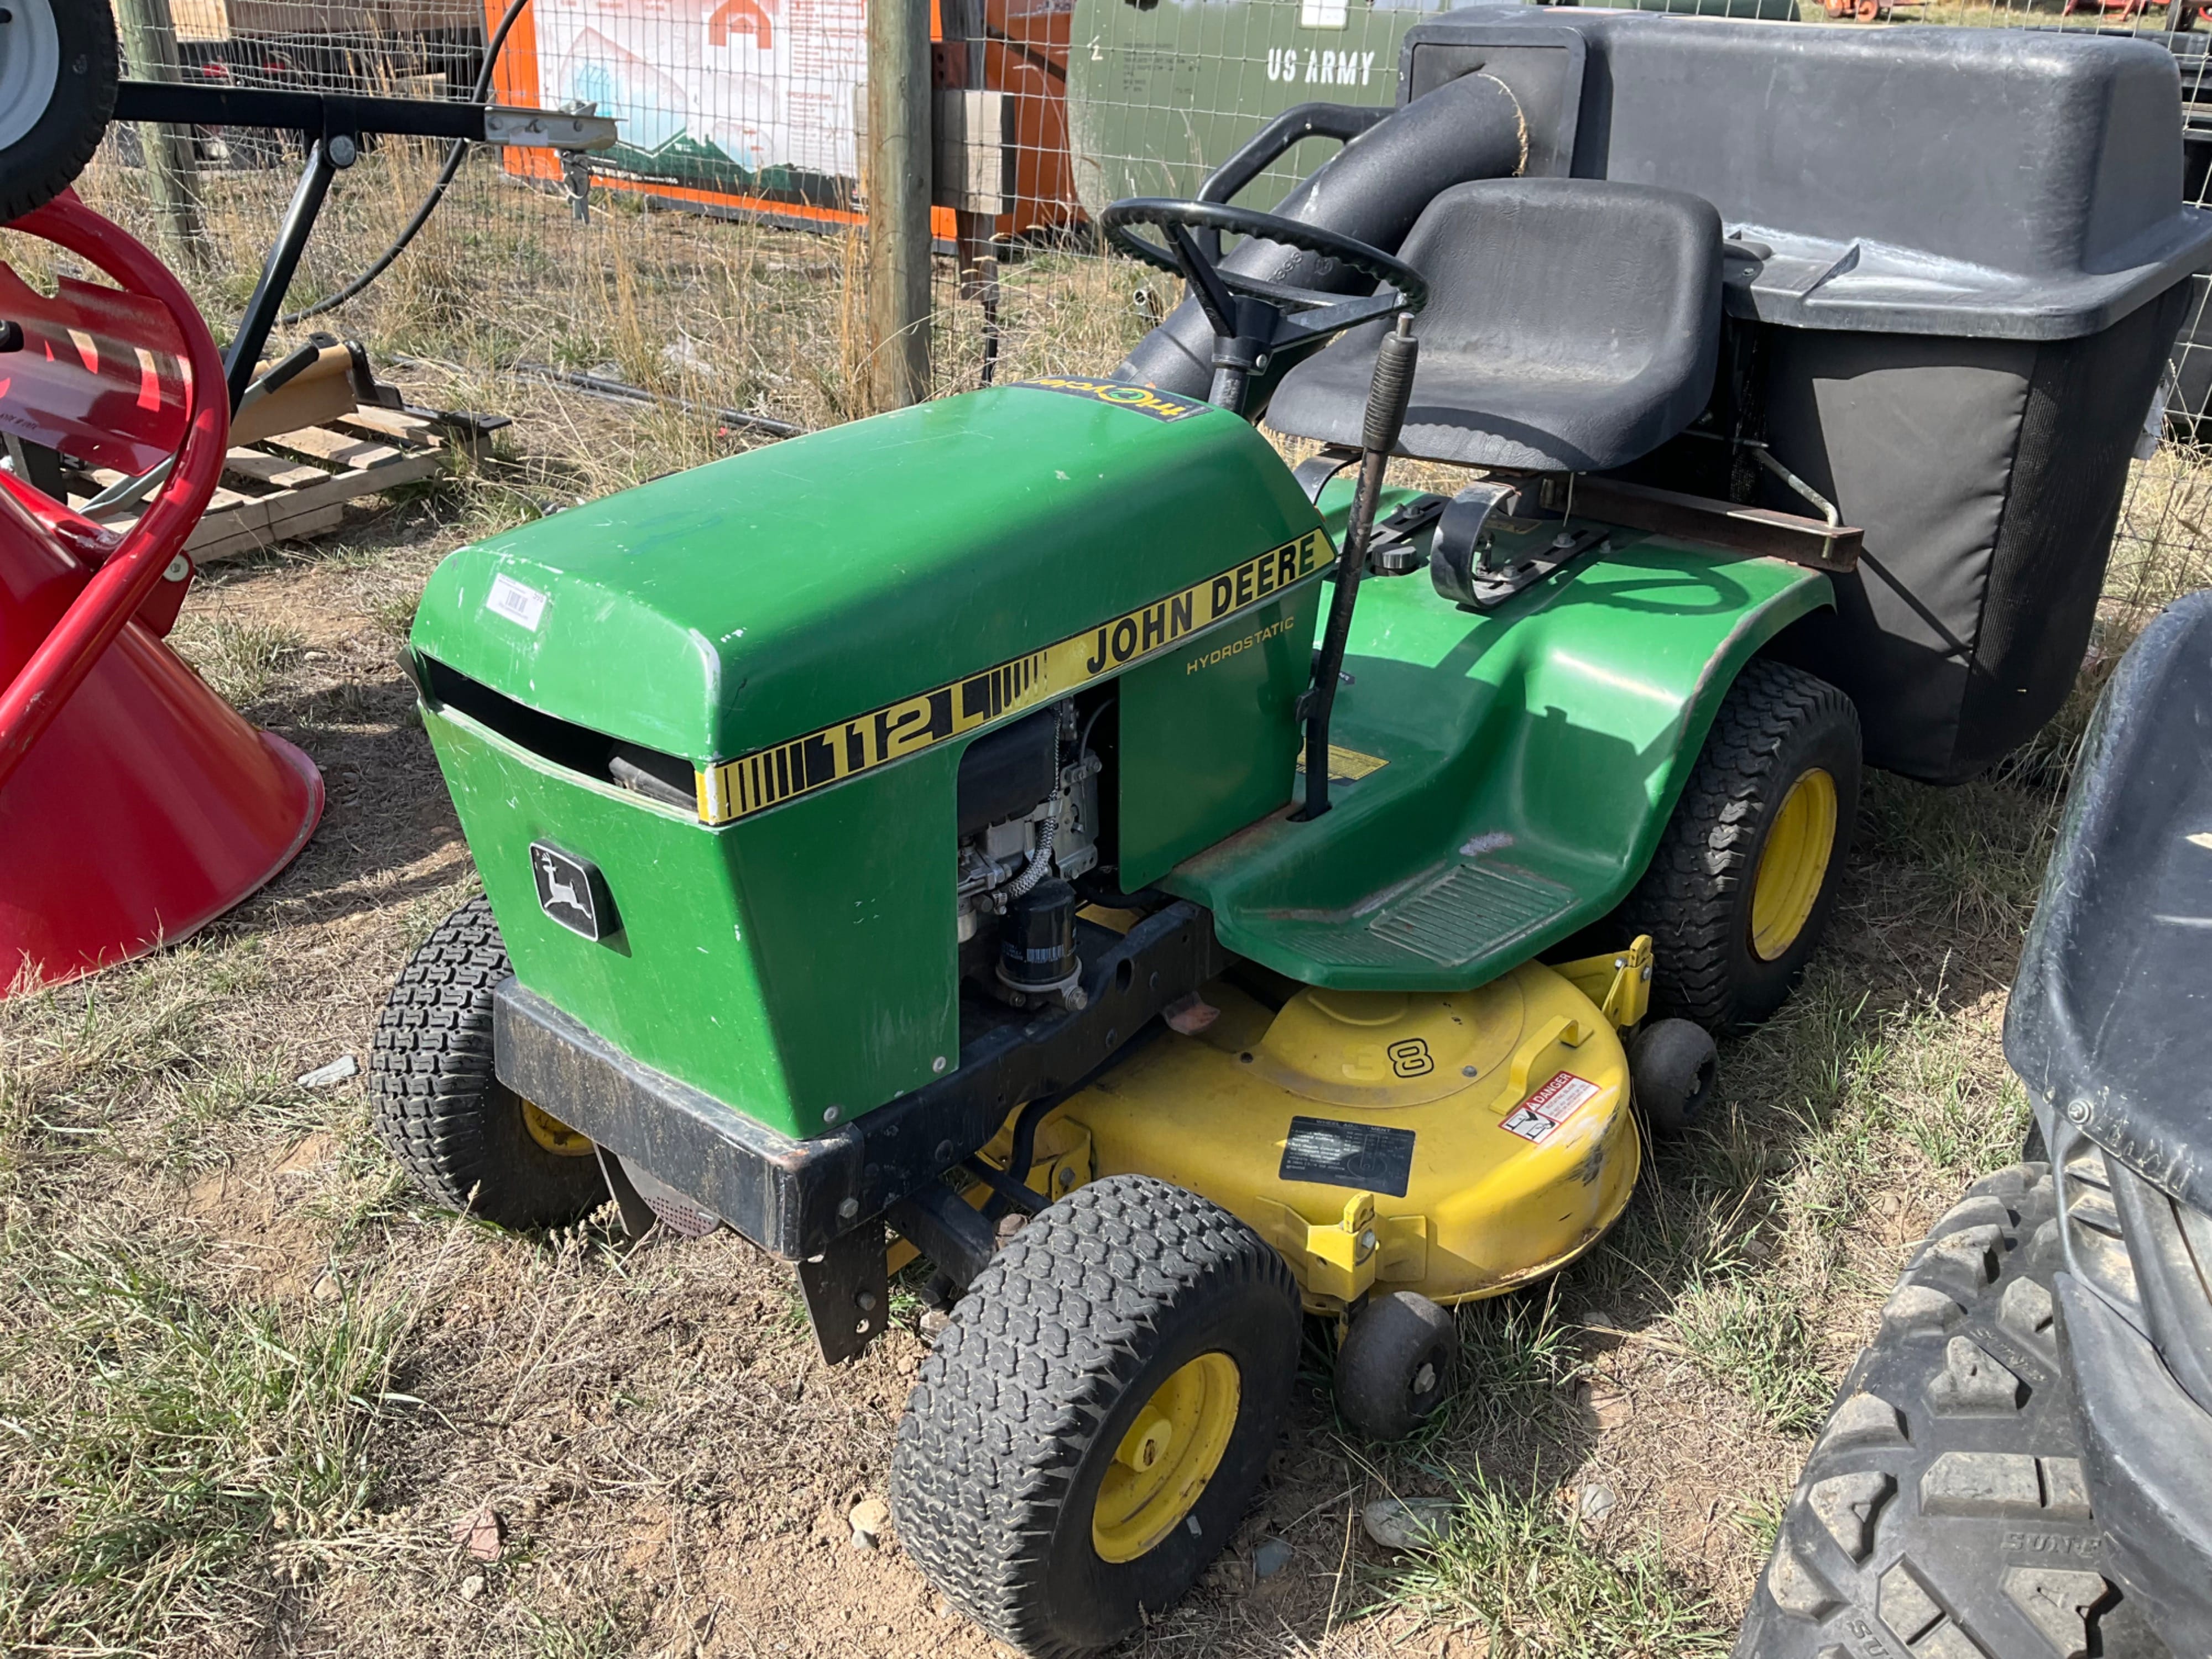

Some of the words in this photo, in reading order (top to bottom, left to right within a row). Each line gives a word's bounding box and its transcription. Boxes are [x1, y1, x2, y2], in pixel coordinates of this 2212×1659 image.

[1267, 48, 1297, 81] US
[1305, 50, 1375, 85] ARMY
[1086, 591, 1193, 675] JOHN
[1211, 534, 1315, 619] DEERE
[1186, 616, 1295, 675] HYDROSTATIC
[822, 696, 933, 778] 112
[952, 682, 983, 733] L
[1533, 1073, 1572, 1103] DANGER
